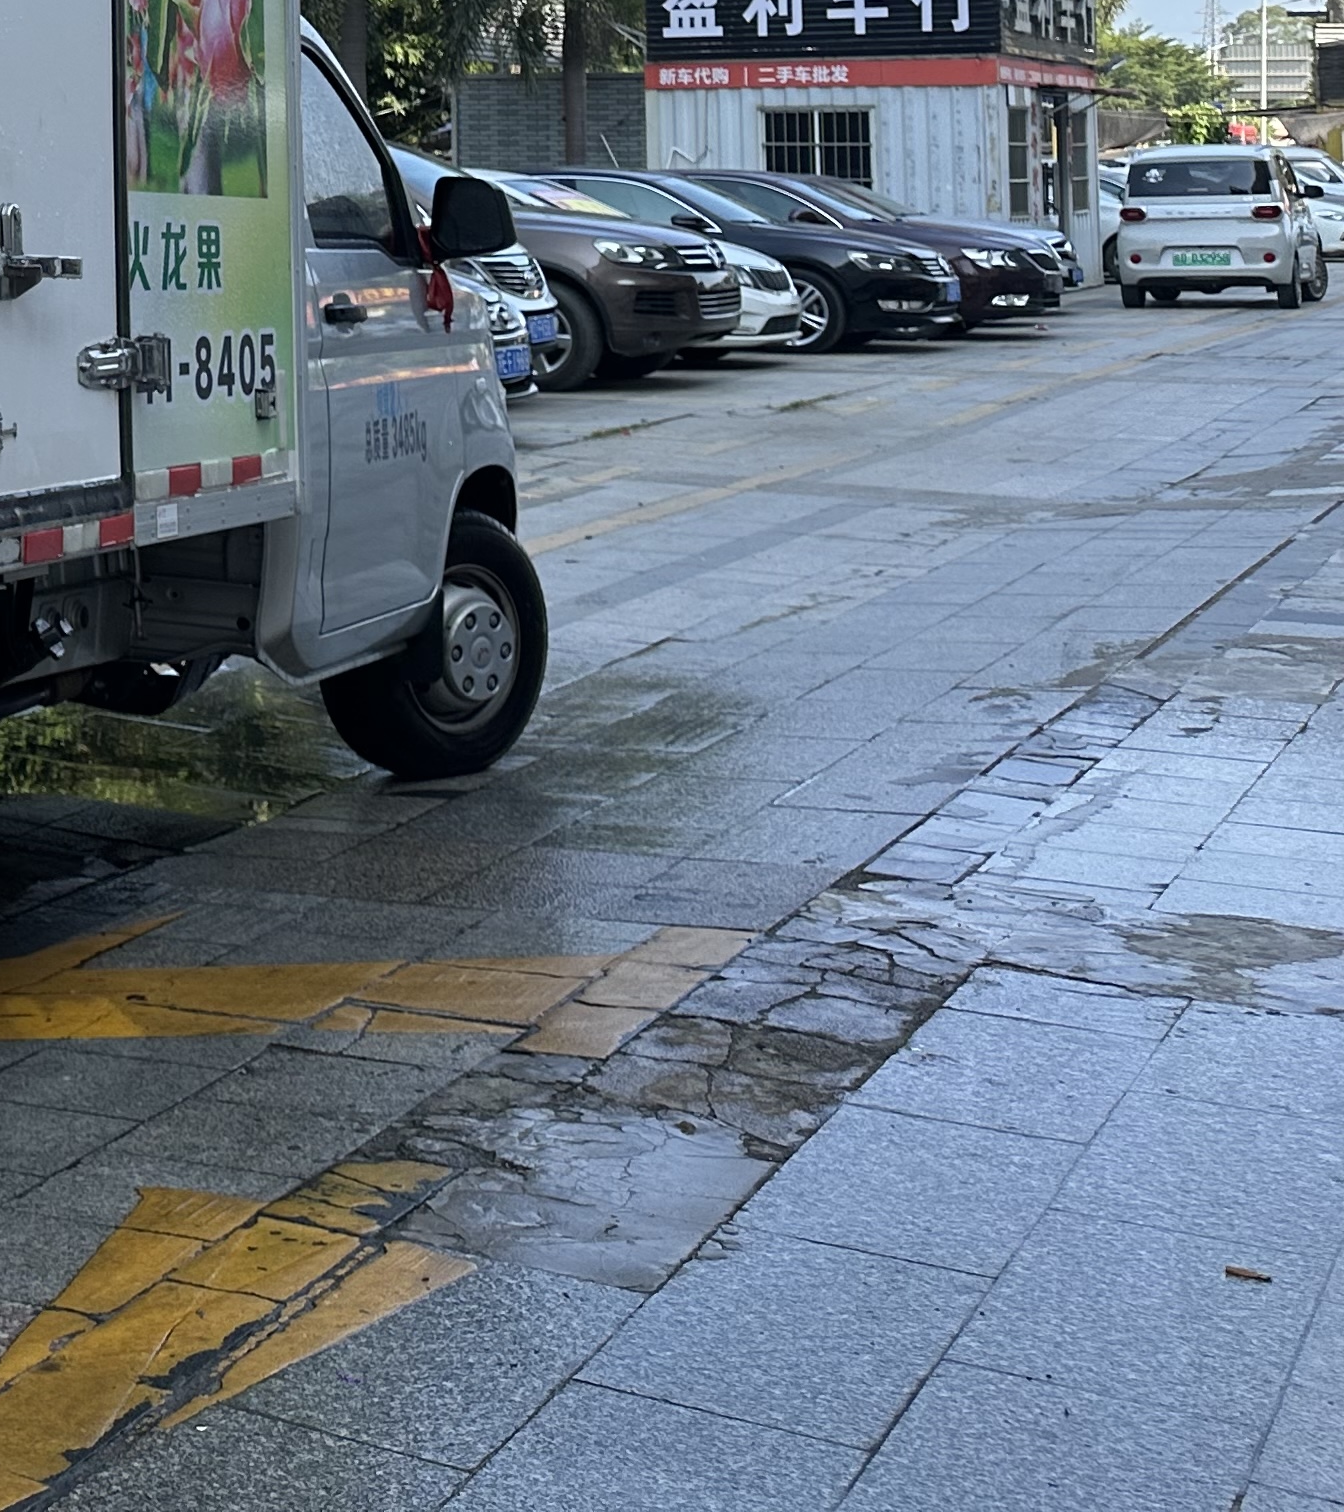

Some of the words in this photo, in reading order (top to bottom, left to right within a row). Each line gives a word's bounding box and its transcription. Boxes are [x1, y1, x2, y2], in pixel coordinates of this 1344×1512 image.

[658, 67, 730, 85] 新车代购
[758, 65, 849, 84] 二手车批发
[128, 221, 222, 291] 火龙果
